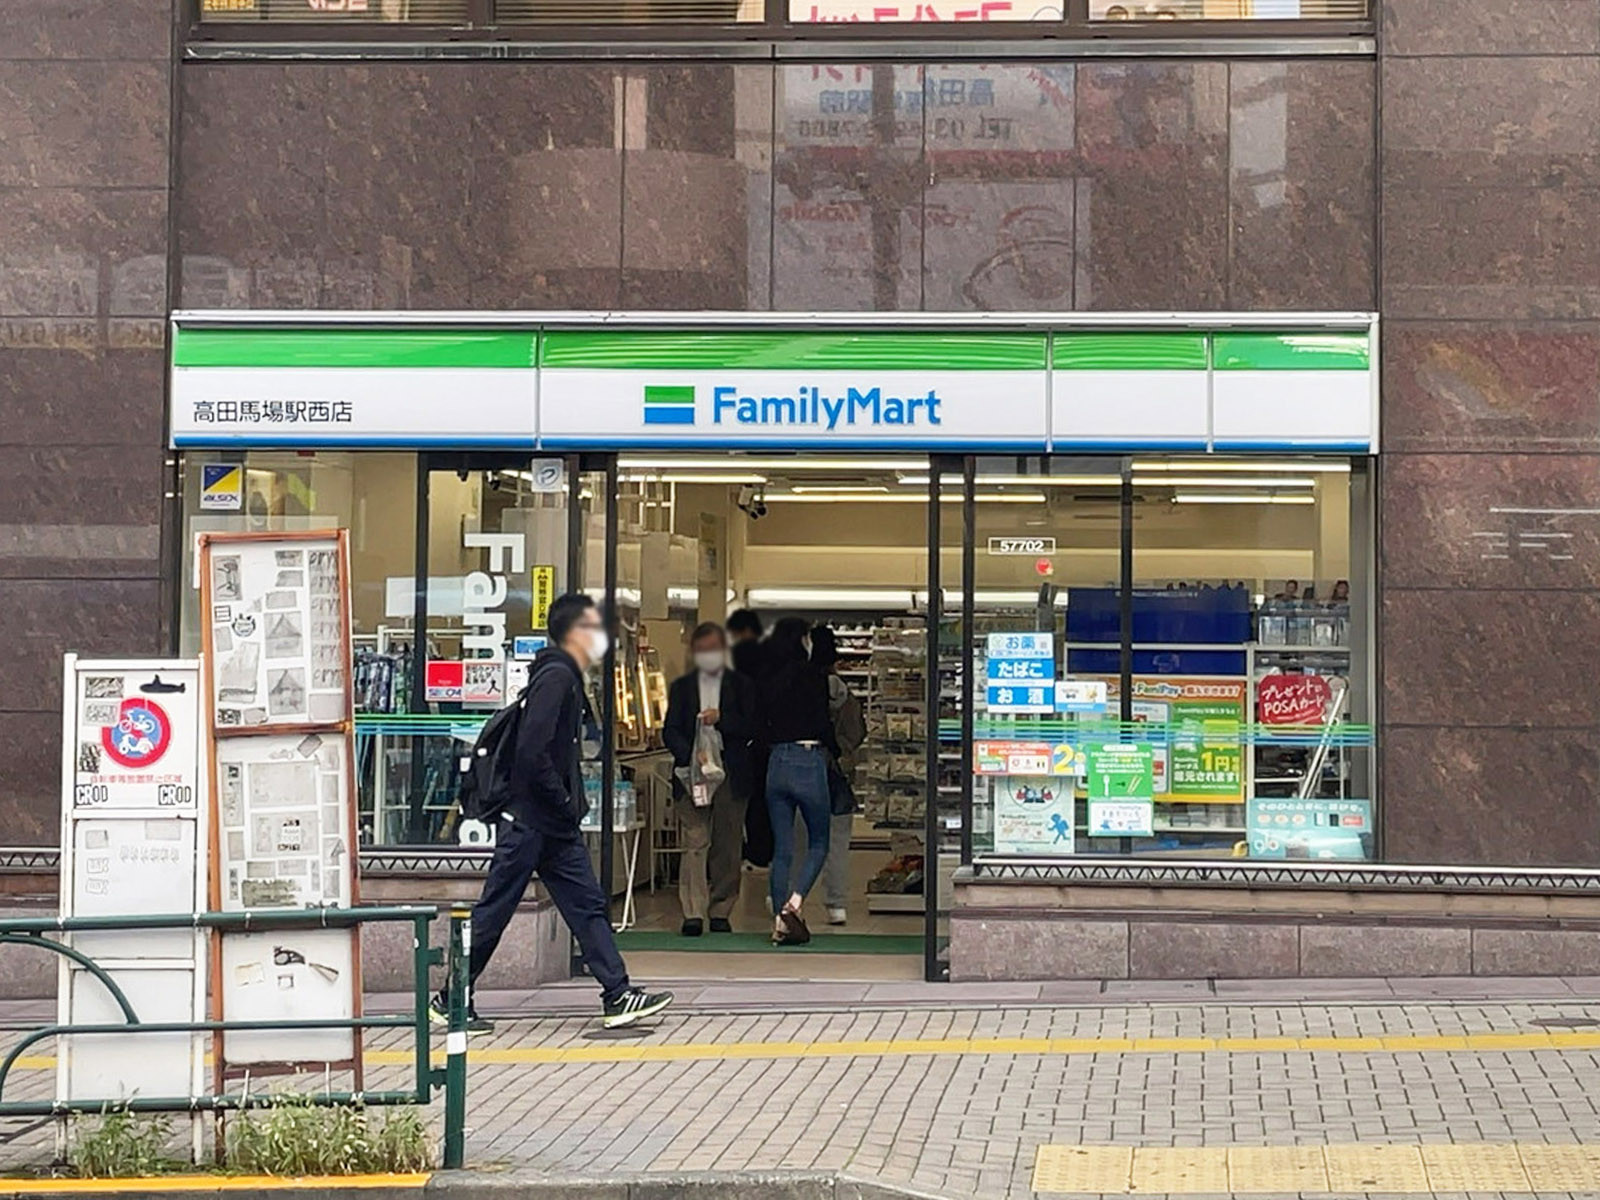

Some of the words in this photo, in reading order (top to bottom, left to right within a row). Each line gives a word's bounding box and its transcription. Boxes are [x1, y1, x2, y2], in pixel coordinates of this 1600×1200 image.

[193, 400, 353, 423] 高田馬場駅西店
[713, 386, 942, 430] FamilyMart
[1000, 540, 1045, 552] 57702
[997, 660, 1044, 678] たばこ
[1263, 694, 1325, 717] POSAカード
[1053, 744, 1075, 774] 2
